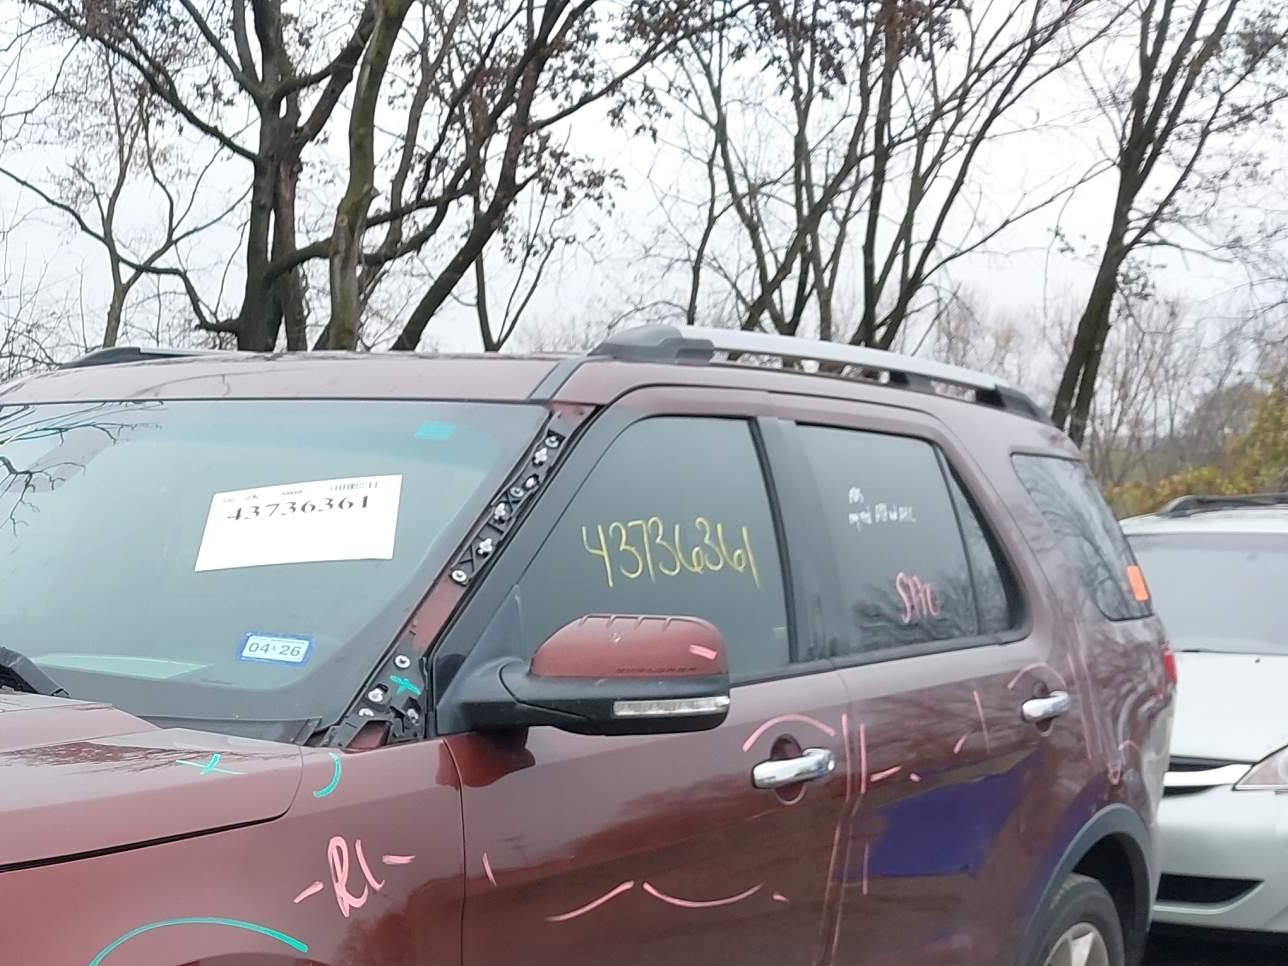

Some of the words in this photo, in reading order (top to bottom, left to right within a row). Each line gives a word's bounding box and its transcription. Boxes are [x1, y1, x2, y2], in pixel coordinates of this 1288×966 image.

[226, 494, 369, 521] 43736361
[581, 516, 761, 590] 43736361
[279, 645, 302, 657] 26
